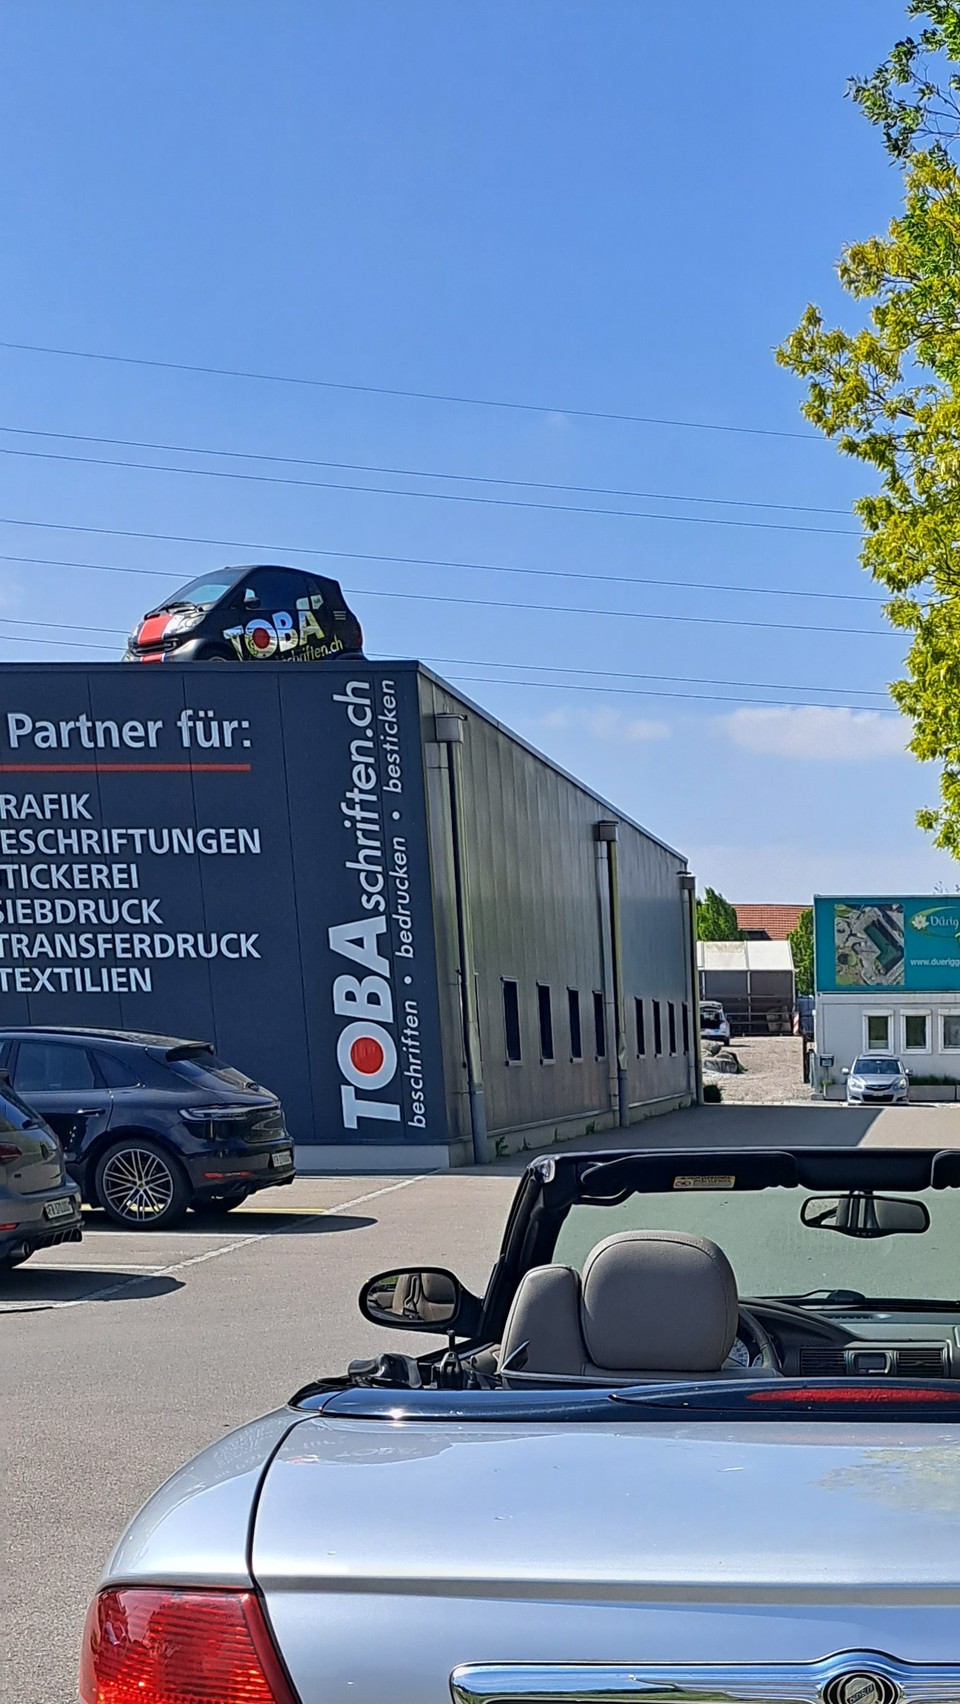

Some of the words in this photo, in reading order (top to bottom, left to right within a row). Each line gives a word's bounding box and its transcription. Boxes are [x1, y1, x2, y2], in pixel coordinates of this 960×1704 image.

[223, 610, 326, 662] TOBA
[7, 711, 163, 749] Partner
[176, 709, 252, 748] für:
[382, 678, 405, 794] besticken
[394, 835, 415, 959] bedrucken
[930, 916, 960, 930] Dürig
[0, 966, 152, 993] TEXTILIEN
[407, 999, 428, 1129] beschriften
